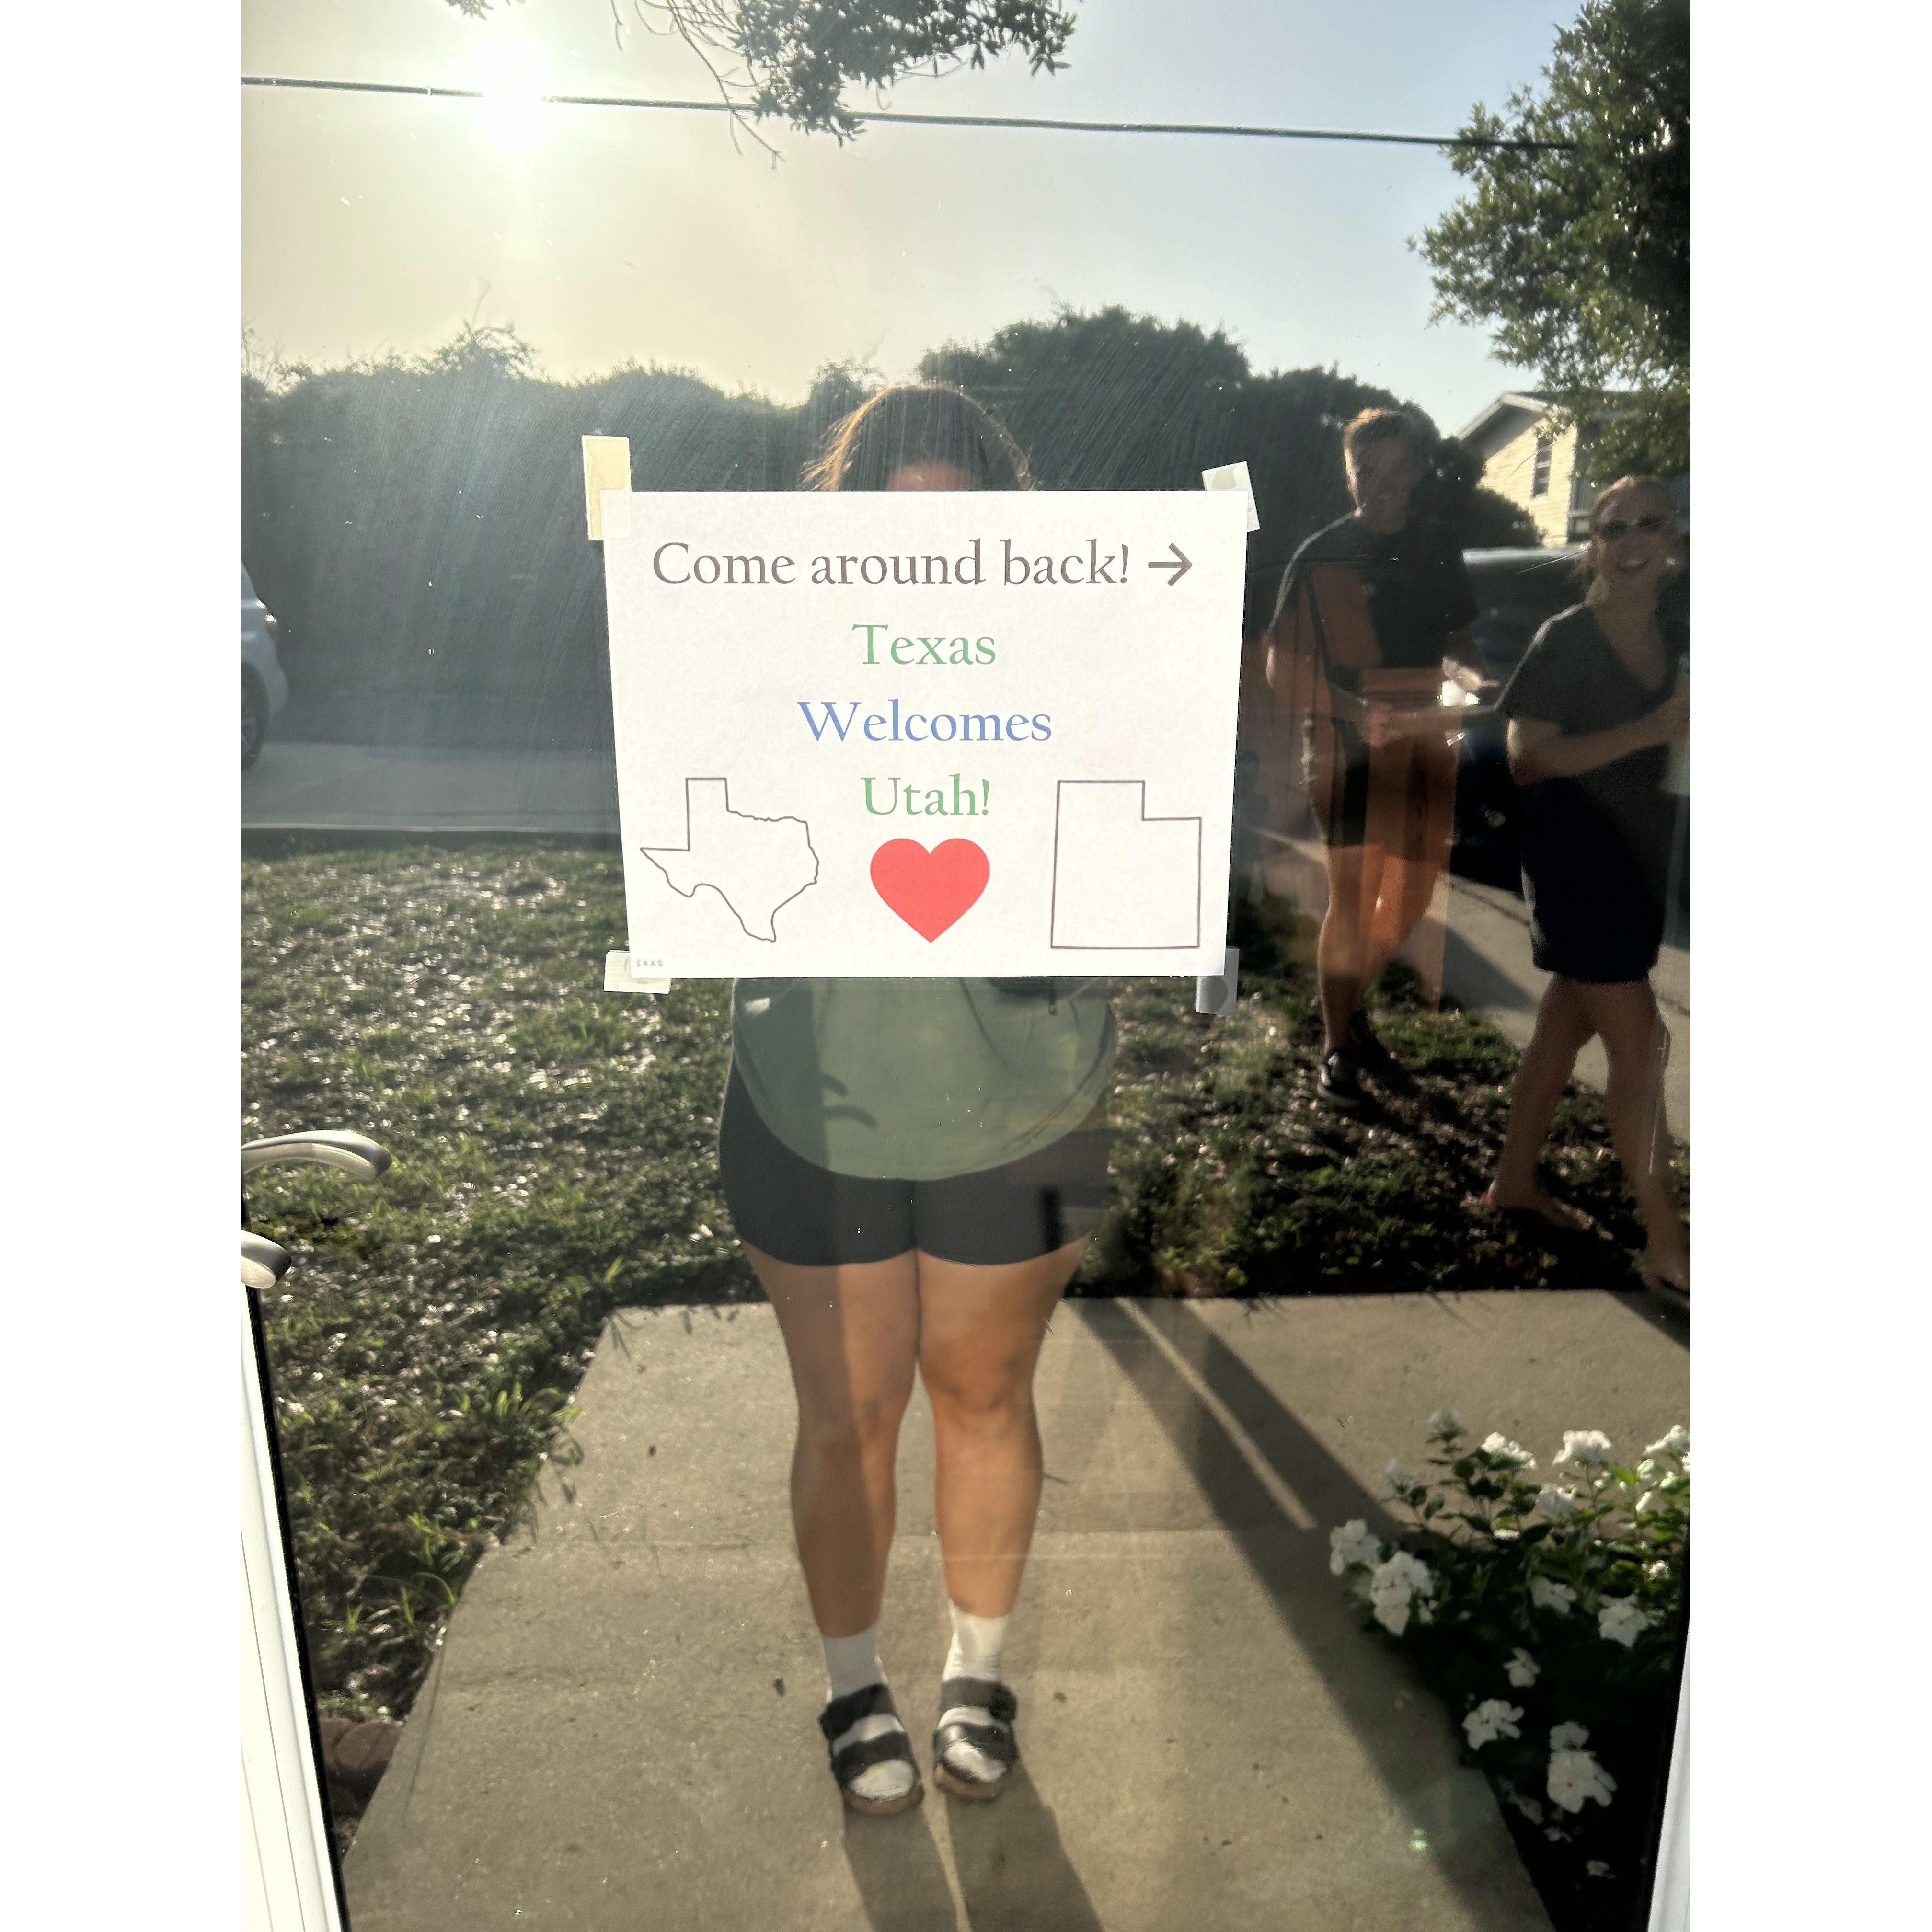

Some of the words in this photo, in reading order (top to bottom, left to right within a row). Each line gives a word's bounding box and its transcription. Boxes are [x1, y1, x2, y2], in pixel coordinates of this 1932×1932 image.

[653, 542, 796, 584] Come
[811, 538, 986, 585] around
[1000, 538, 1128, 586] back!
[852, 624, 996, 665] Texas
[797, 698, 1052, 741] Welcomes
[861, 773, 989, 816] Utah!
